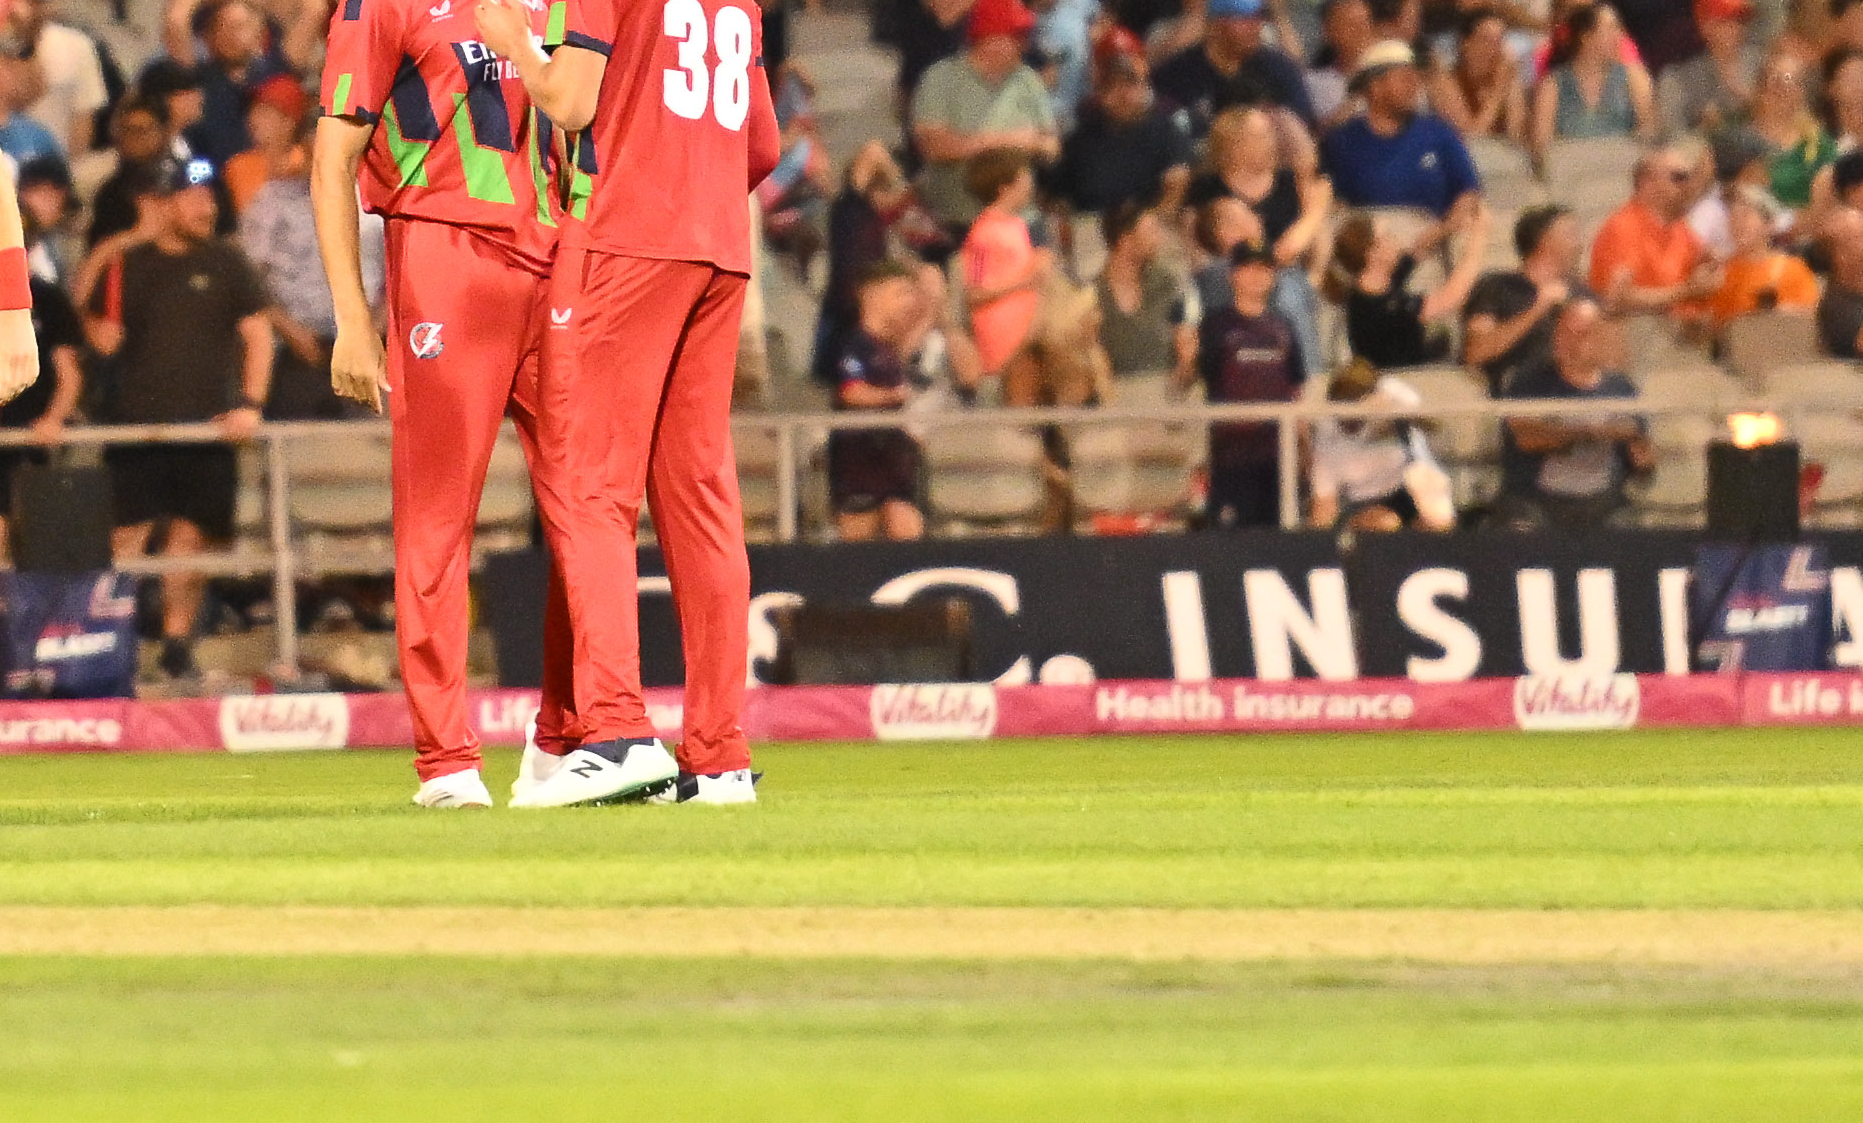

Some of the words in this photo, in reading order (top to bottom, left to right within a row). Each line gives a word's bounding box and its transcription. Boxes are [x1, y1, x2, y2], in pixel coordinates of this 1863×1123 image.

[1096, 683, 1224, 720] Health
[1234, 684, 1414, 720] insurance
[1769, 678, 1841, 714] Life
